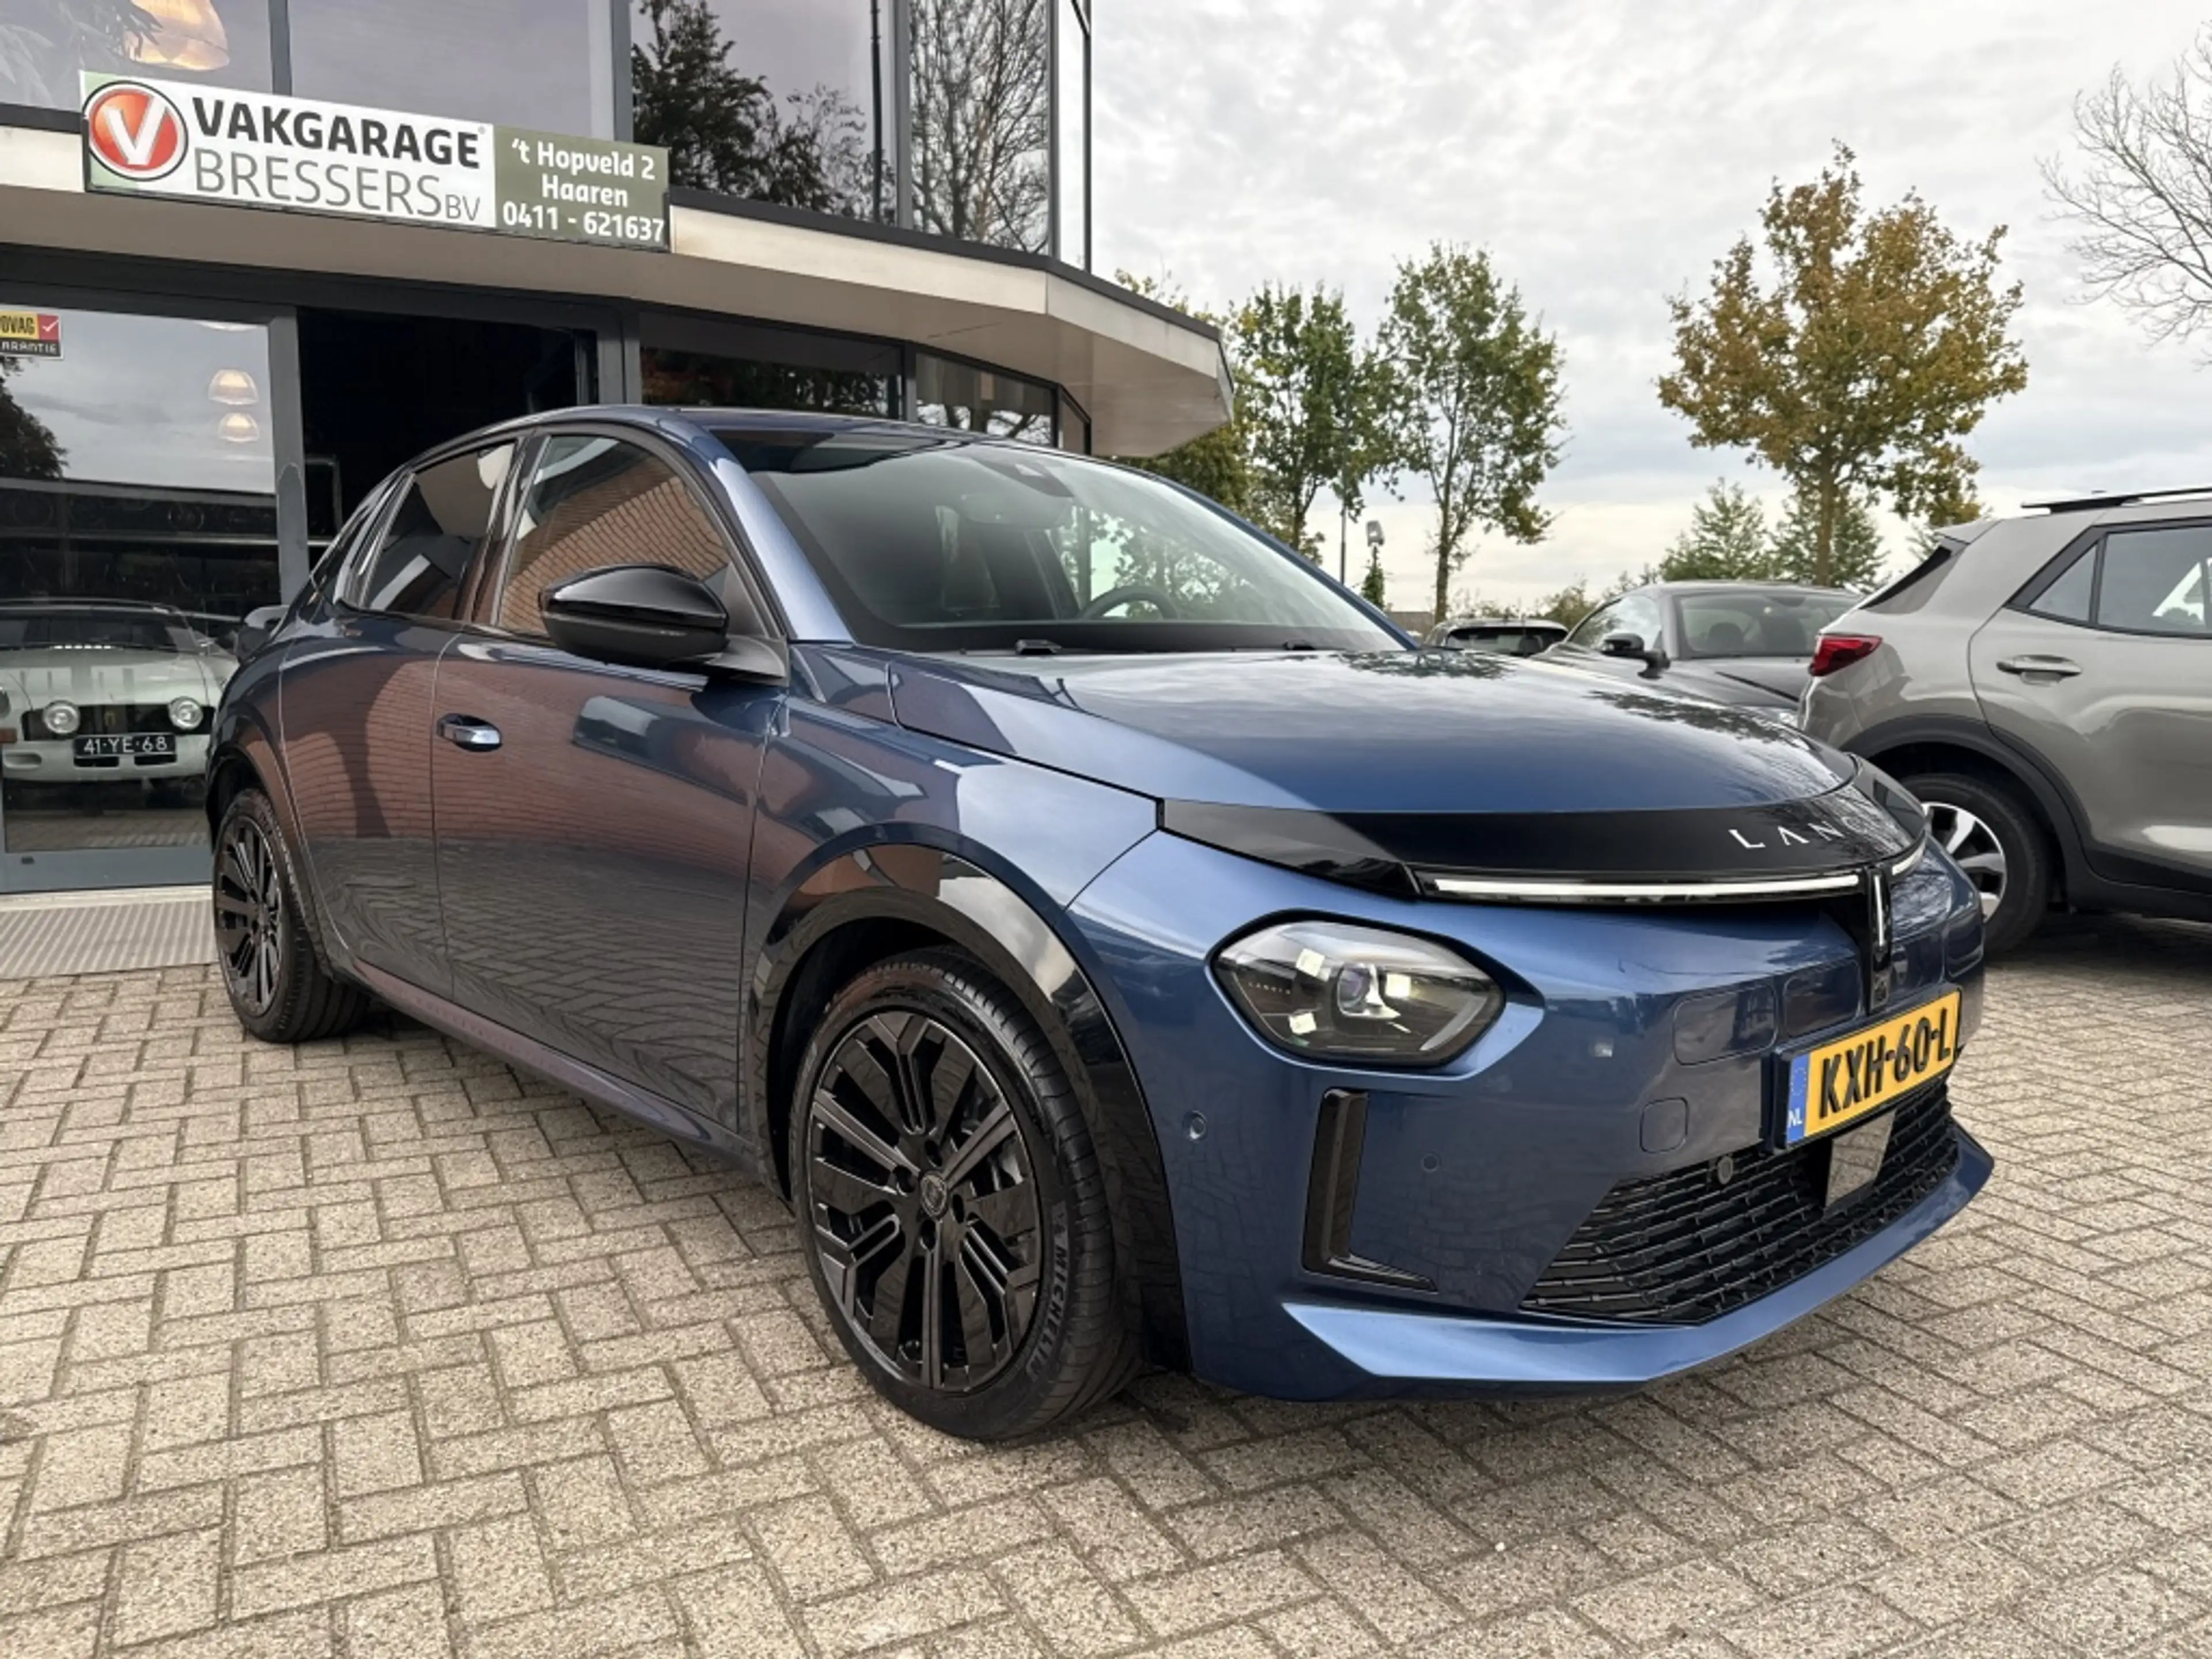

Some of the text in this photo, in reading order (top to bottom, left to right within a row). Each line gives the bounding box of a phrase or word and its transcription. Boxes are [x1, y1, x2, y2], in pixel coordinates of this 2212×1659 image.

[192, 97, 479, 169] VAKGARAGE
[537, 141, 634, 177] Hopveld
[641, 156, 656, 181] 2
[541, 174, 628, 208] Haaren
[502, 200, 559, 230] 0411
[584, 211, 665, 243] 621637
[0, 316, 35, 335] OVAG
[1819, 1006, 1951, 1119] KXH-60-L
[1787, 1108, 1803, 1128] NL
